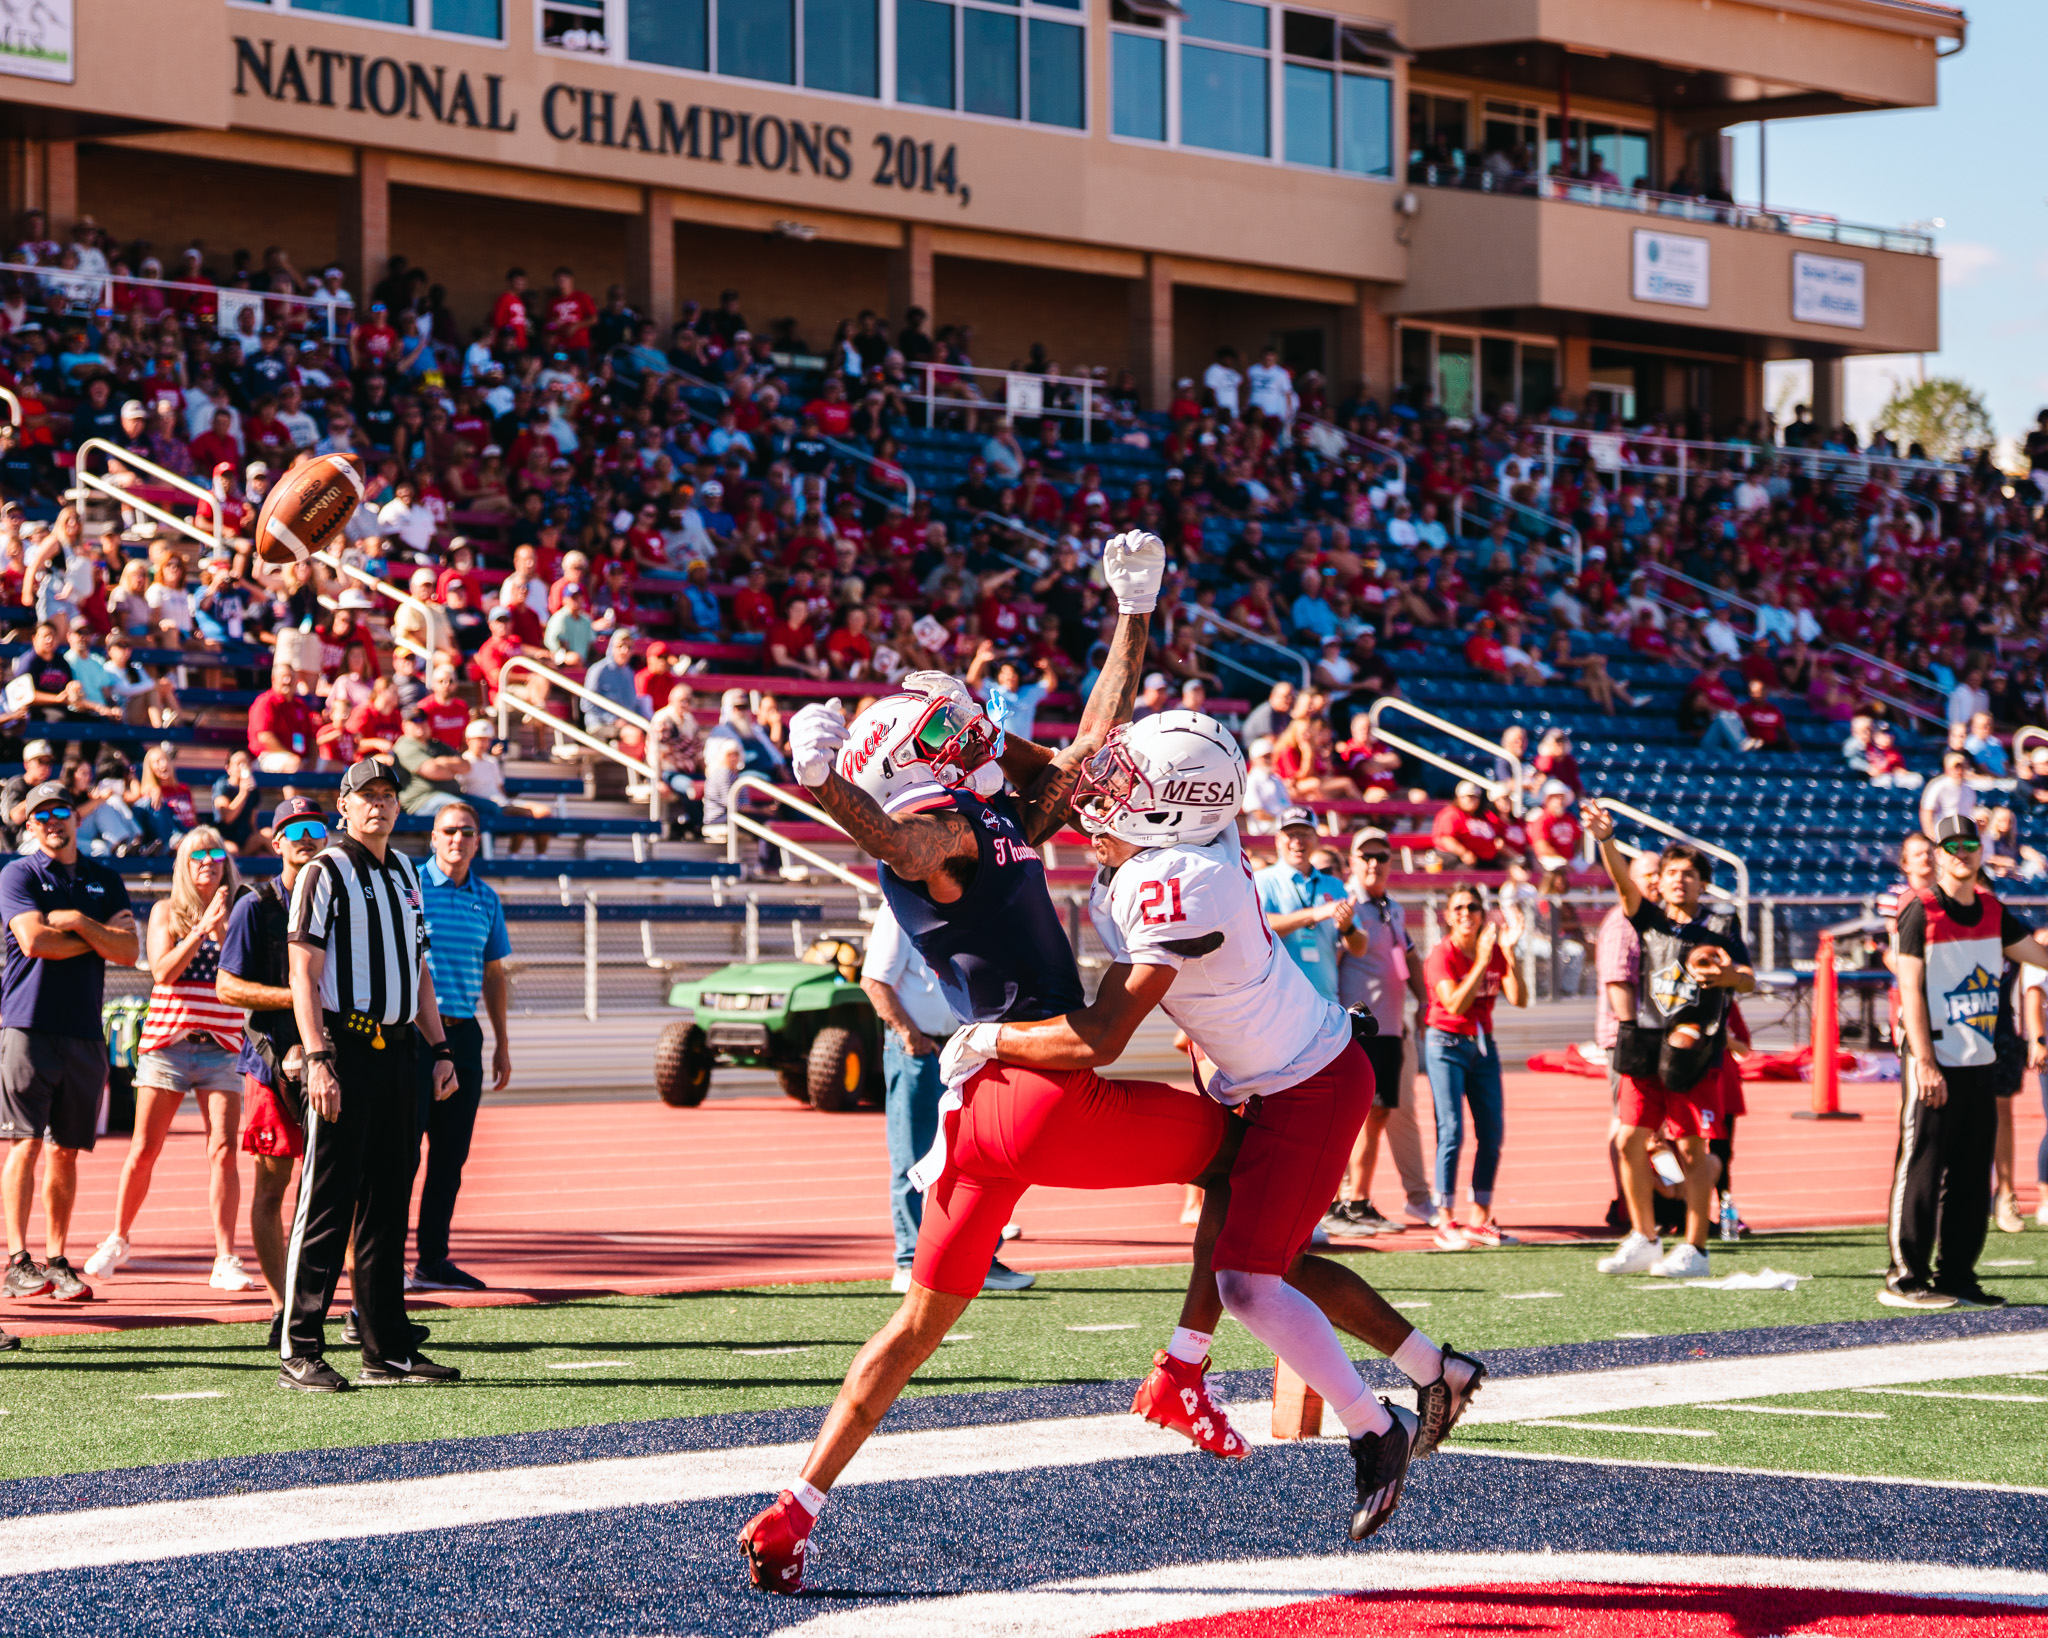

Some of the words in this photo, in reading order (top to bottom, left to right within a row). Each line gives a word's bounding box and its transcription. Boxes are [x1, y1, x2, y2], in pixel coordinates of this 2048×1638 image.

[231, 35, 517, 133] NATIONAL
[541, 82, 853, 181] CHAMPIONS
[872, 133, 971, 208] 2014,
[303, 486, 342, 522] Wilson
[842, 719, 889, 786] Pack
[1037, 757, 1081, 815] BORN
[1162, 779, 1235, 803] MESA
[291, 798, 306, 814] P
[364, 886, 374, 899] S
[1139, 877, 1187, 926] 21
[1652, 979, 1698, 1000] RMAC
[1949, 991, 1999, 1020] RMA
[1701, 1108, 1715, 1130] P
